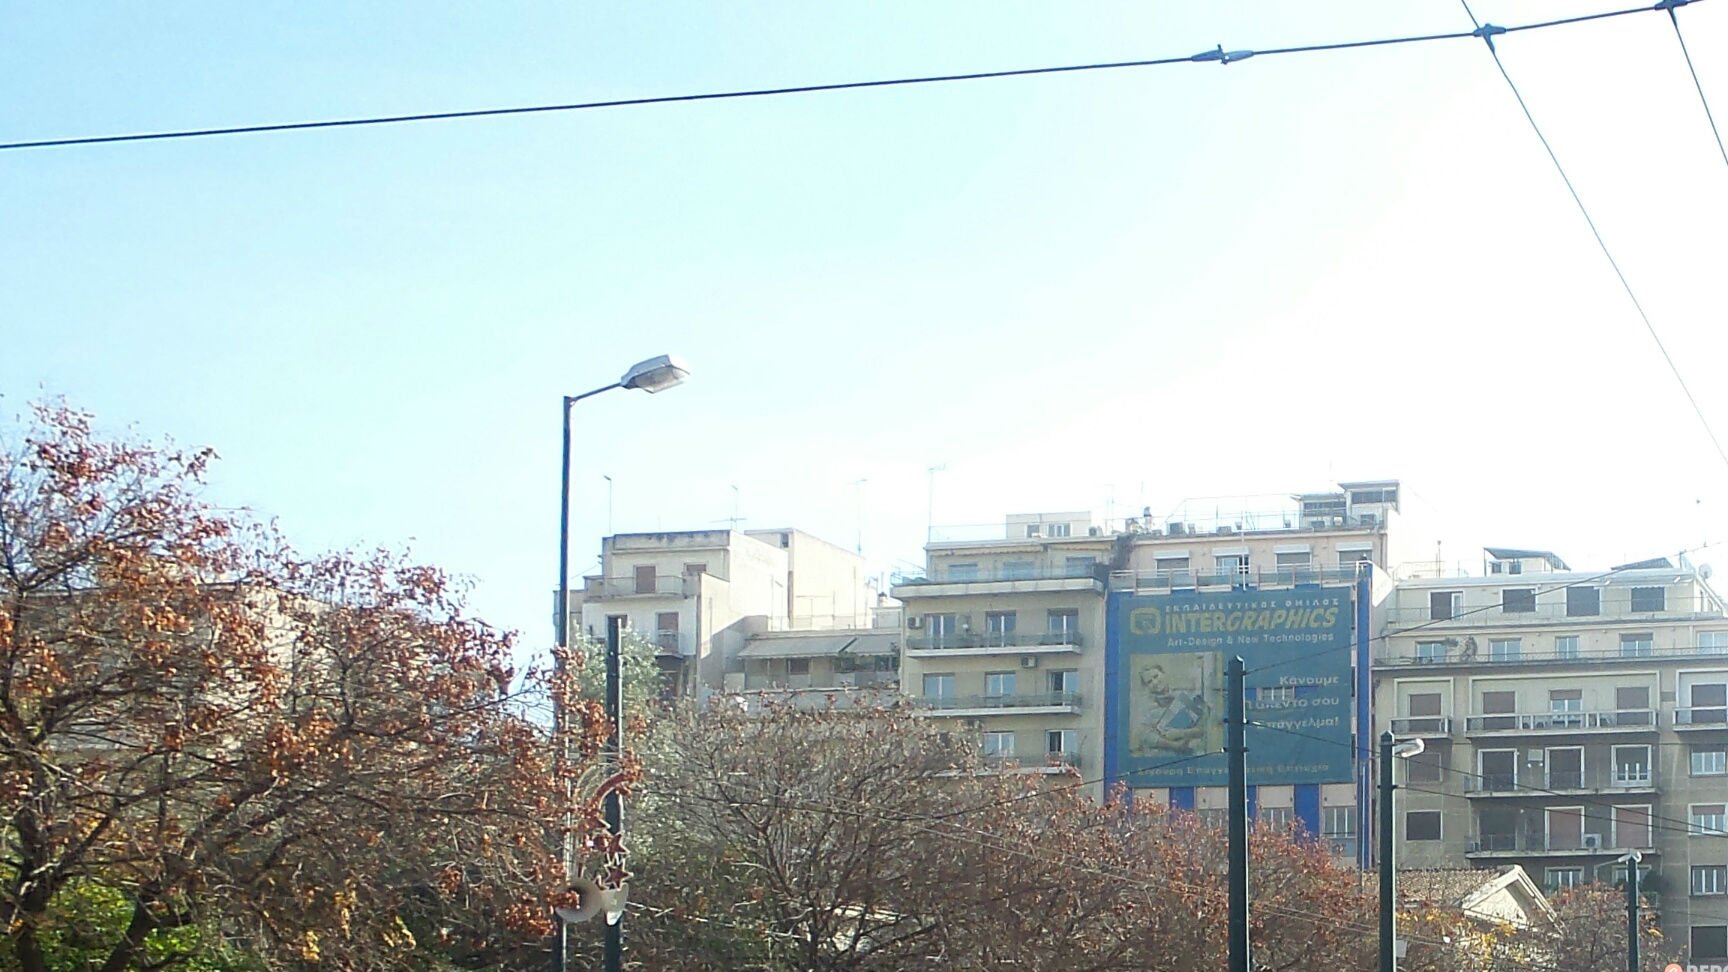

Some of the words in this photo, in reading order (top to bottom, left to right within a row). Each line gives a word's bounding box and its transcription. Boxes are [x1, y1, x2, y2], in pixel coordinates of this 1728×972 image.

[1165, 607, 1338, 634] INTERGRAPHICS
[1167, 635, 1223, 648] Art-Design
[1238, 635, 1259, 645] New
[1264, 632, 1335, 643] Technologies
